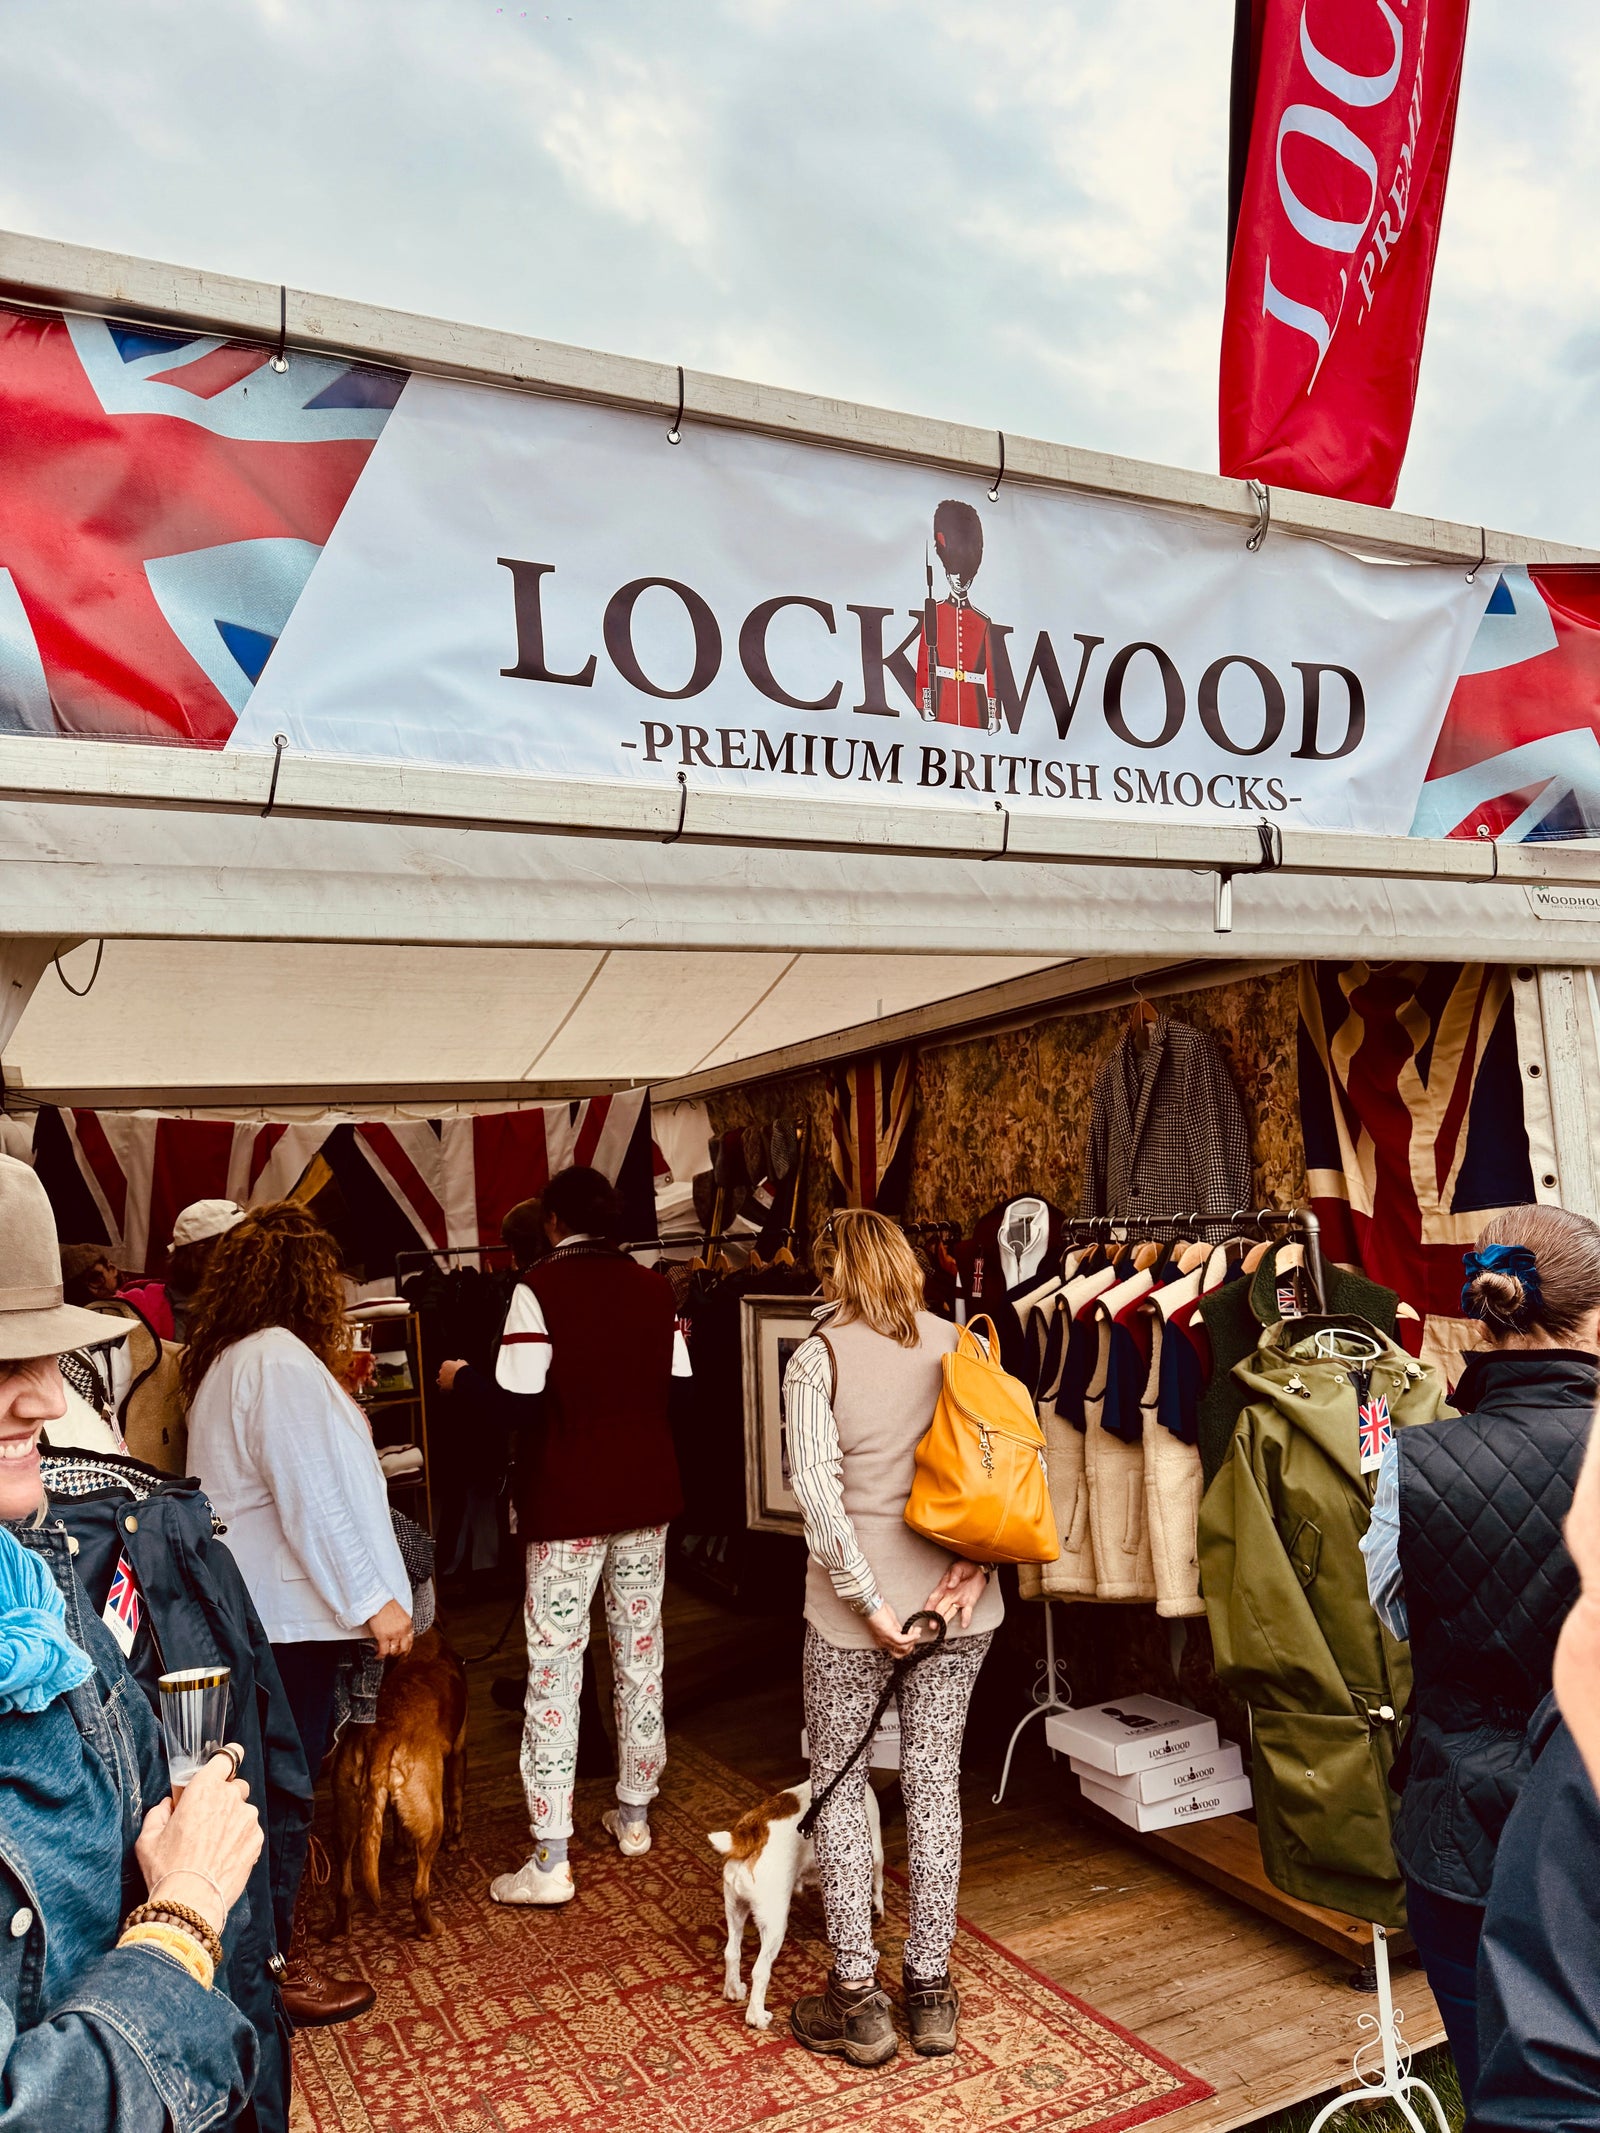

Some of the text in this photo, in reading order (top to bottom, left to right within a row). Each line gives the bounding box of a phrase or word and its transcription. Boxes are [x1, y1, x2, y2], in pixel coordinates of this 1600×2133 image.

[1262, 0, 1407, 396] LOC
[497, 557, 1366, 760] LOCKWOOD
[621, 721, 1302, 812] -PREMIUM BRITISH SMOCKS-
